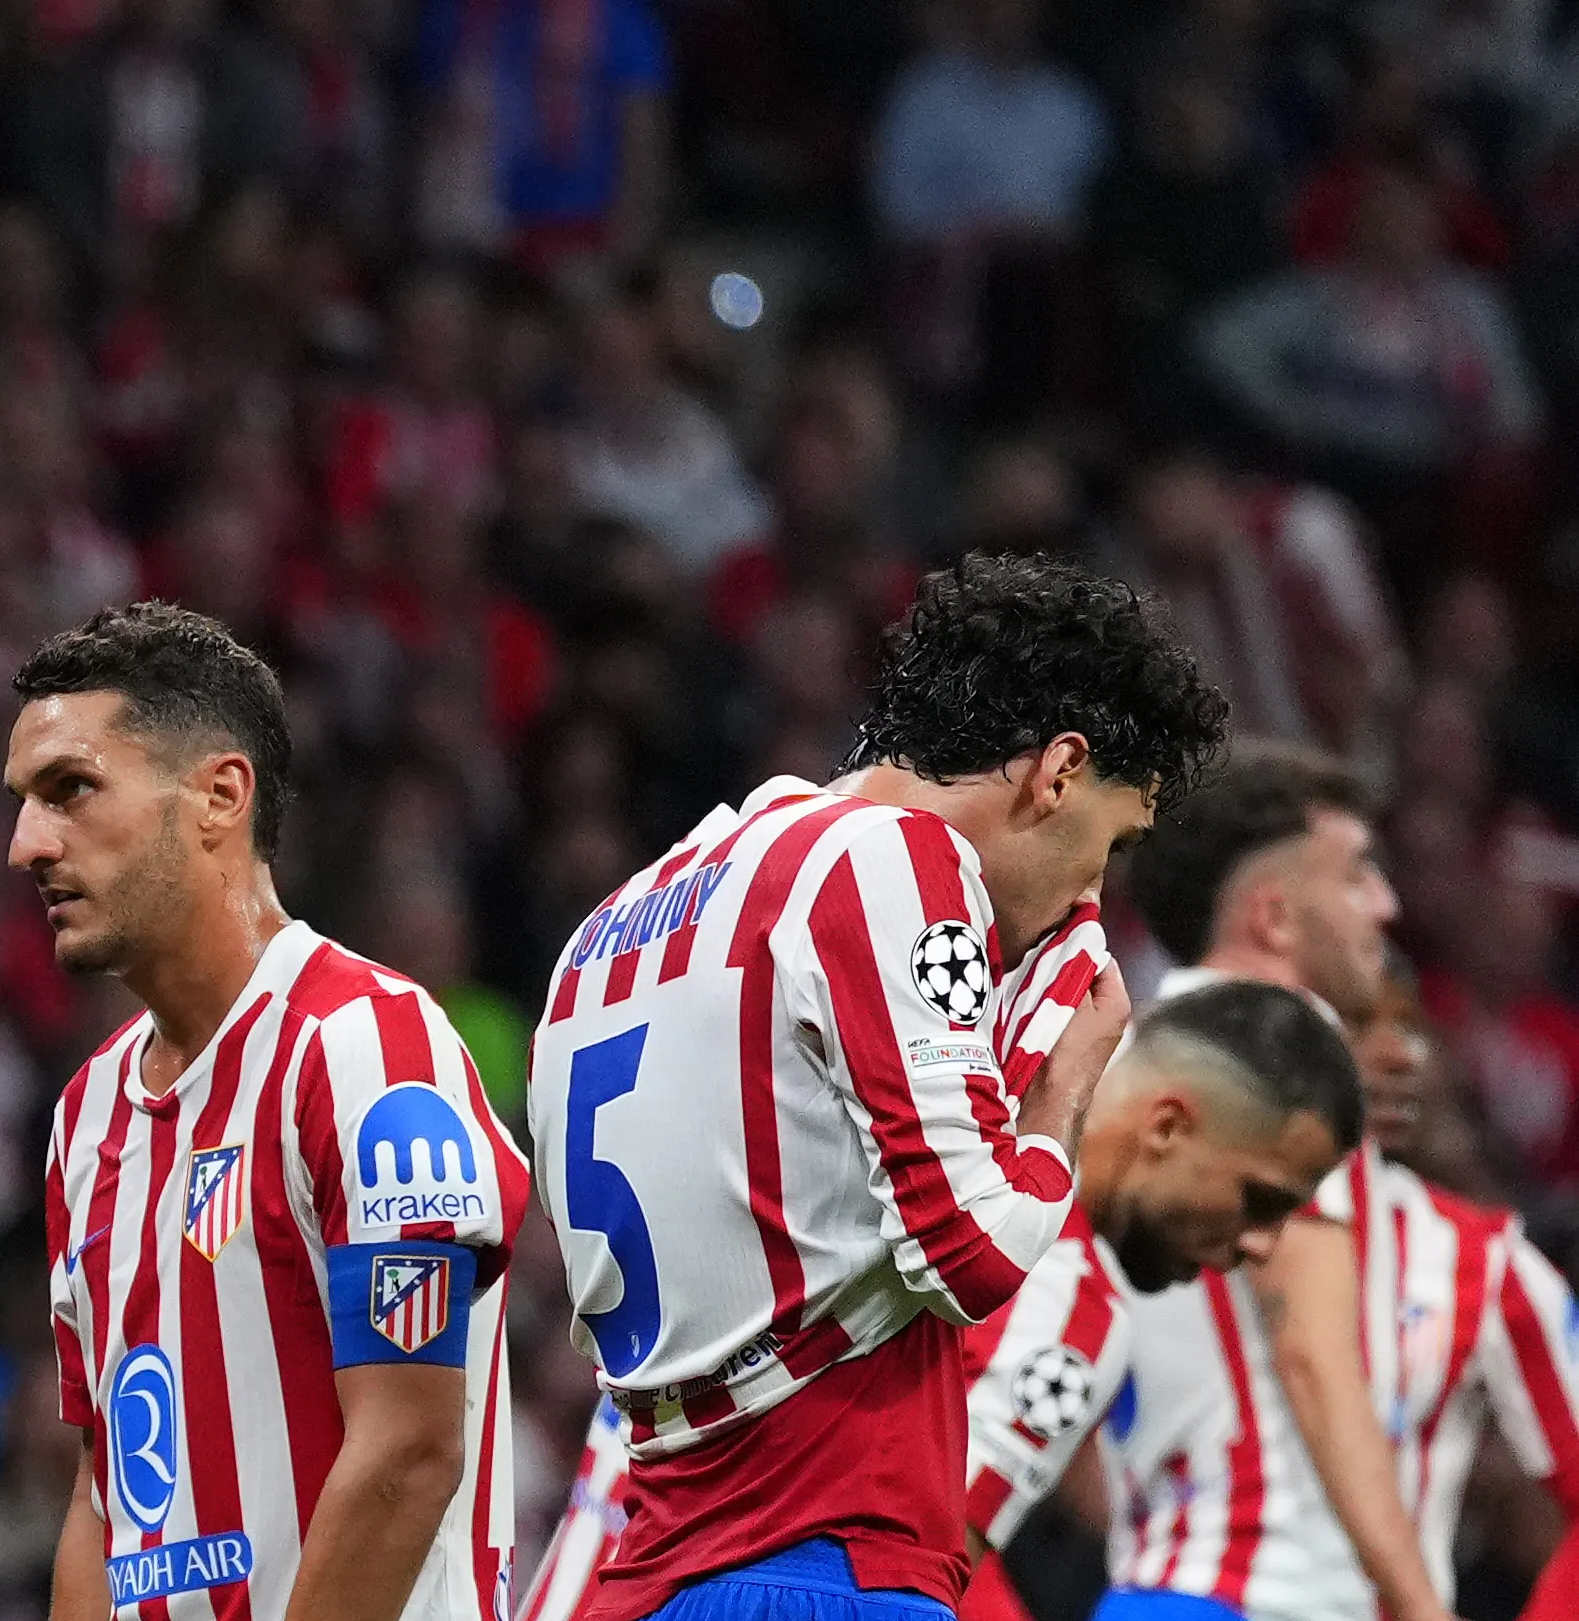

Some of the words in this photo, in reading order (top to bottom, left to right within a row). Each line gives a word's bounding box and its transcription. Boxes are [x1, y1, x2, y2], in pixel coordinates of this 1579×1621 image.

[363, 1191, 485, 1225] kraken
[564, 1021, 662, 1379] 5
[184, 1538, 246, 1585] AIR
